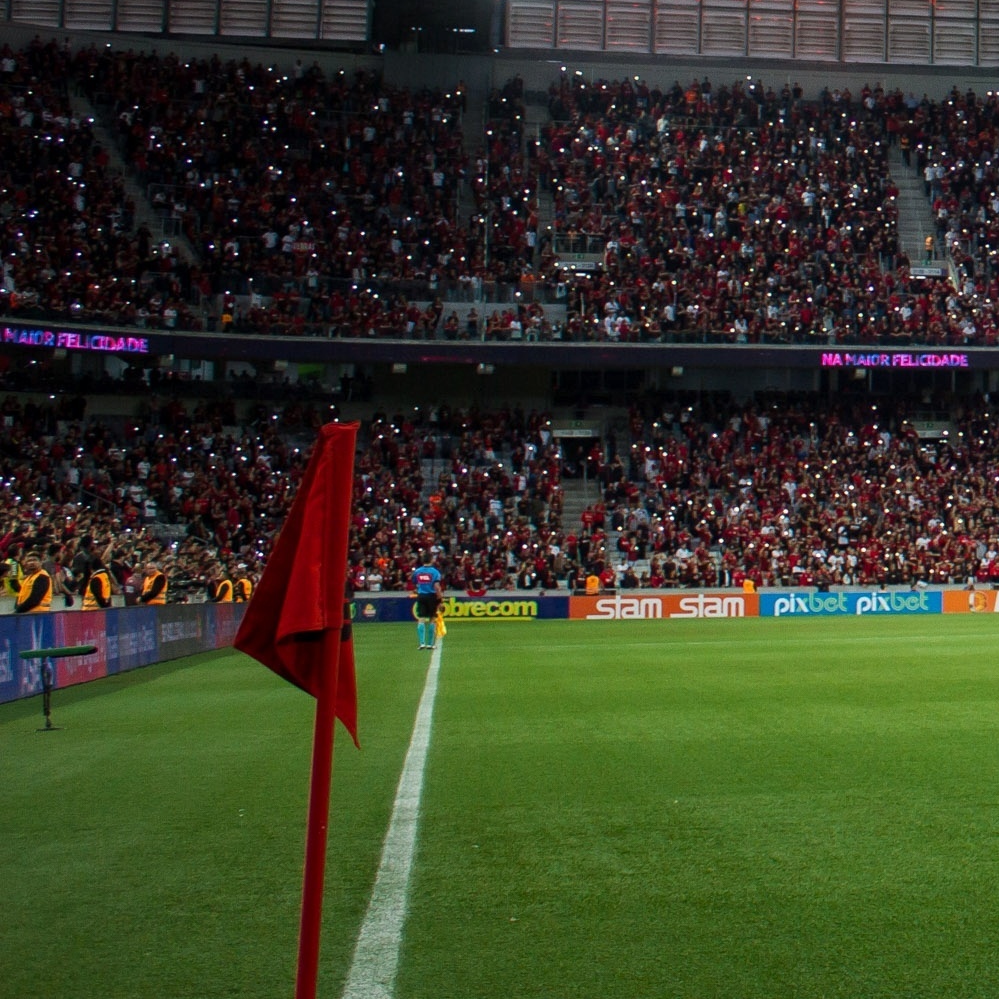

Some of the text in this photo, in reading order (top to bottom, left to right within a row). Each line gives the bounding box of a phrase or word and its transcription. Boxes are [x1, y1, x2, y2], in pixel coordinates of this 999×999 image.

[4, 327, 149, 352] MAIOR FELICIDADE
[821, 353, 969, 367] NA MAIOR FELICIDADE
[586, 593, 744, 620] stam stam
[774, 592, 929, 617] pixbet pixbet
